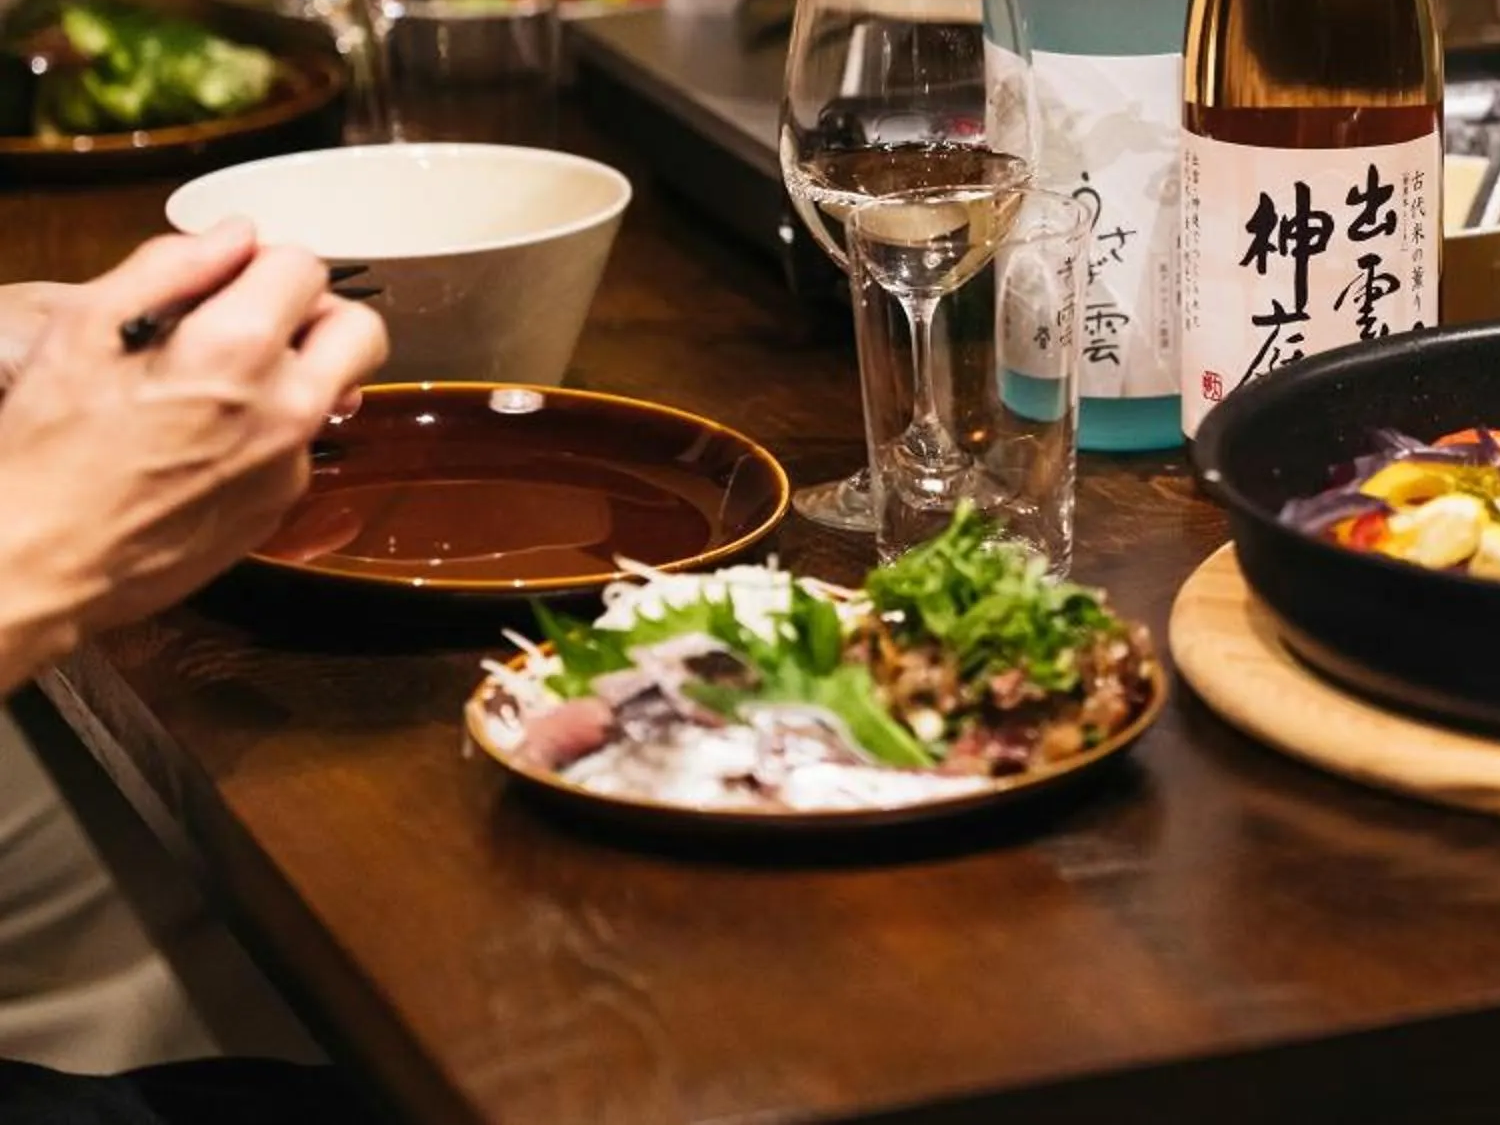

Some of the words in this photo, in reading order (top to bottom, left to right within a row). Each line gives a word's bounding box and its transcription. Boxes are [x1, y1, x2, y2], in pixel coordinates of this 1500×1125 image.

[1333, 162, 1401, 340] 出雲
[1411, 169, 1426, 312] 古代米の薫り
